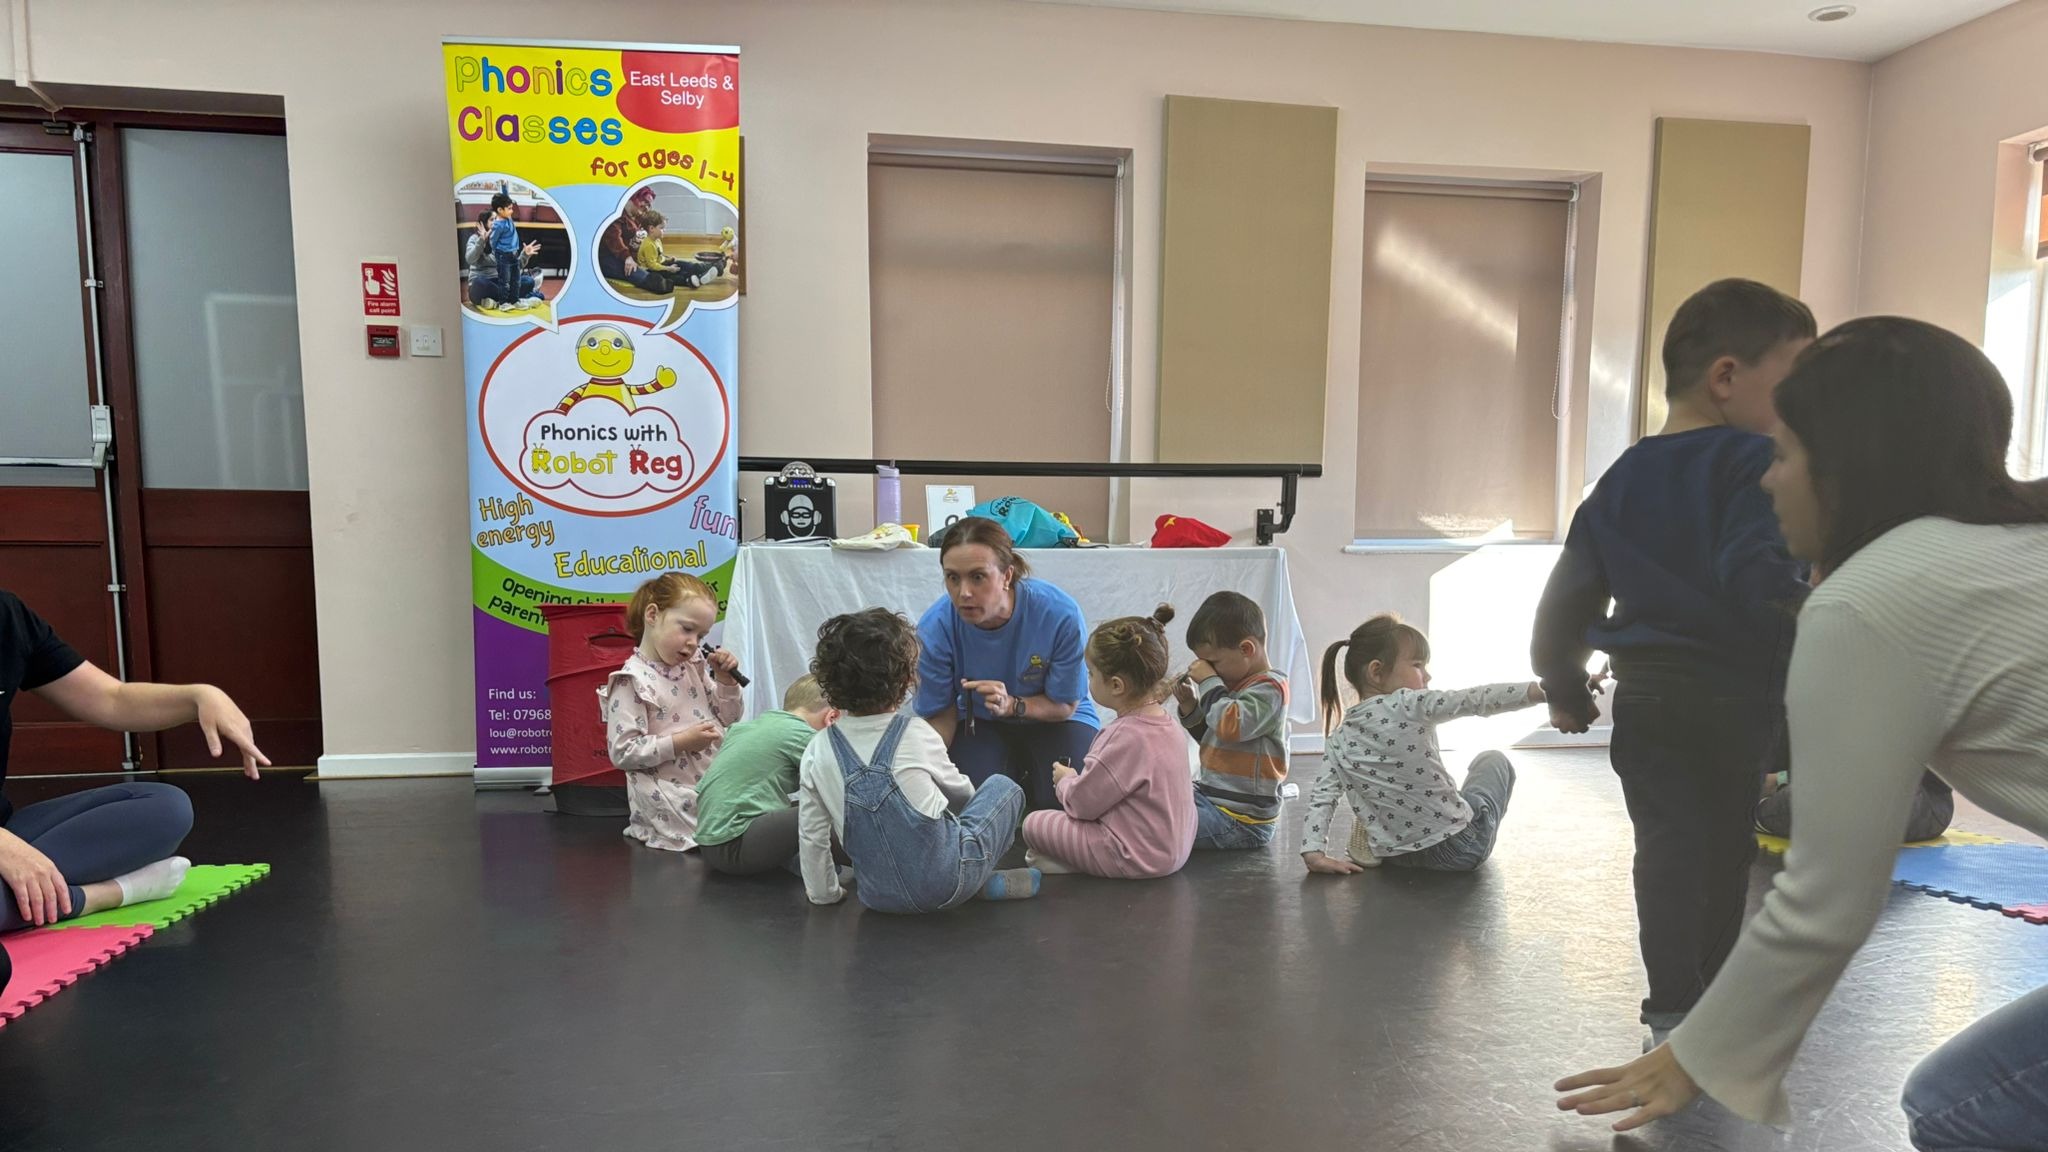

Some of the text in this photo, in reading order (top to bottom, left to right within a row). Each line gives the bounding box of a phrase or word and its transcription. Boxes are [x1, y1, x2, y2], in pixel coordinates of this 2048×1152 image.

[455, 55, 613, 97] Phonics
[630, 71, 734, 91] East Leeds &
[660, 90, 704, 109] Selby
[457, 106, 623, 146] Classes
[590, 148, 735, 191] for ages 1-4
[541, 423, 667, 442] Phonics with
[531, 447, 683, 481] Robot Reg
[478, 493, 534, 526] High
[689, 495, 737, 539] fun
[477, 519, 555, 548] energy
[554, 540, 707, 578] Educational
[488, 688, 536, 700] Find us:
[488, 709, 551, 720] Tel: 07968
